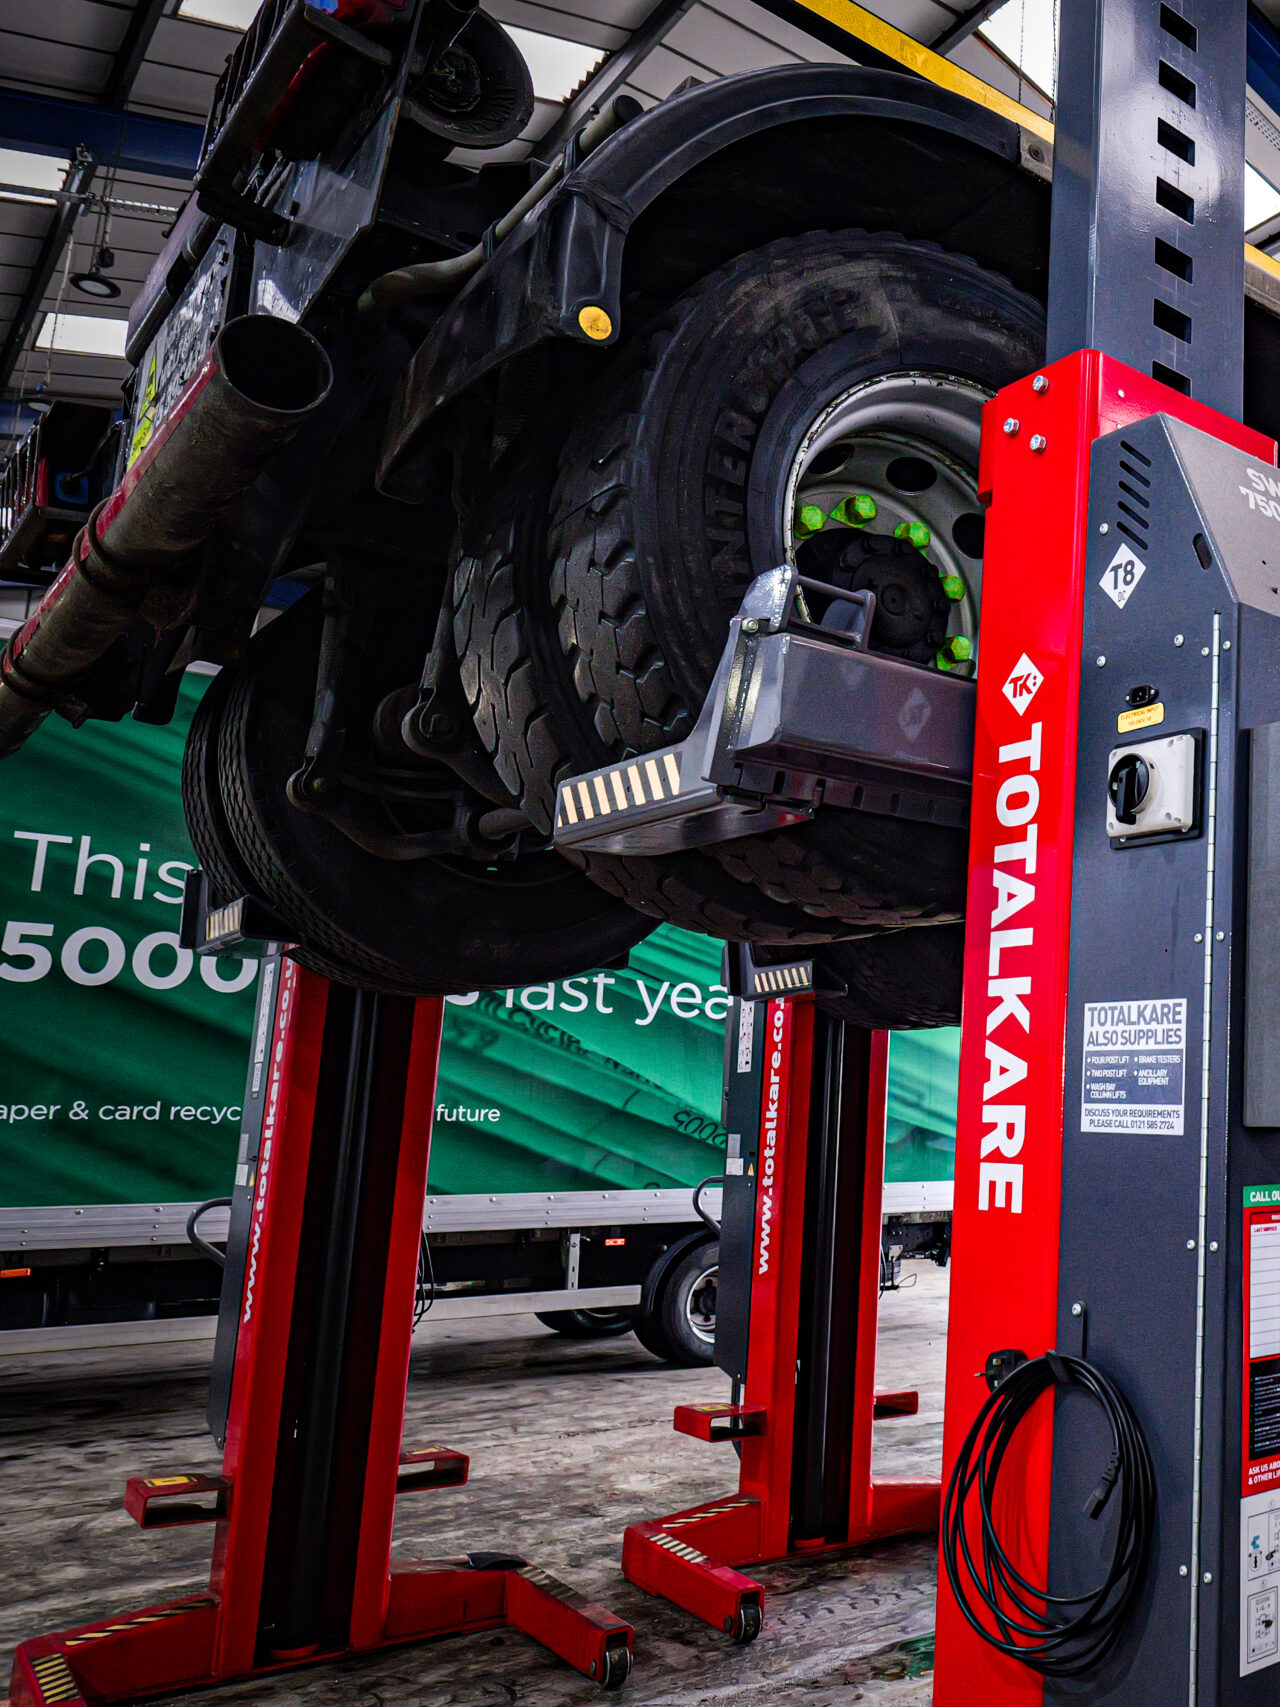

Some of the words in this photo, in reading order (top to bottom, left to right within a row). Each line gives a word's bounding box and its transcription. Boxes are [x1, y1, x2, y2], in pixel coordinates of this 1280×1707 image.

[1108, 559, 1135, 591] T8
[13, 830, 187, 905] This
[975, 723, 1045, 1217] TOTALKARE
[1088, 1003, 1182, 1027] TOTALKARE
[1087, 1030, 1118, 1046] ALSO
[1120, 1028, 1182, 1045] SUPPLIES
[1092, 1056, 1105, 1064] FOUR
[69, 1101, 89, 1120] &
[98, 1100, 160, 1121] card
[436, 1103, 500, 1122] future
[1085, 1108, 1111, 1117] DISCUSS
[1111, 1109, 1129, 1118] YOUR
[1129, 1109, 1180, 1118] REQUIREMENTS
[243, 944, 295, 1323] www.totalkare.co.u
[1090, 1119, 1113, 1127] PLEASE
[1114, 1120, 1129, 1128] CALL
[1131, 1120, 1145, 1128] 0121
[1146, 1121, 1158, 1129] 585
[1159, 1121, 1174, 1130] 2724
[758, 997, 785, 1275] www.totalkare.co.
[1250, 1190, 1270, 1202] CALL
[1249, 1464, 1260, 1475] ASK
[1261, 1463, 1268, 1472] US
[1254, 1473, 1272, 1483] OTHER
